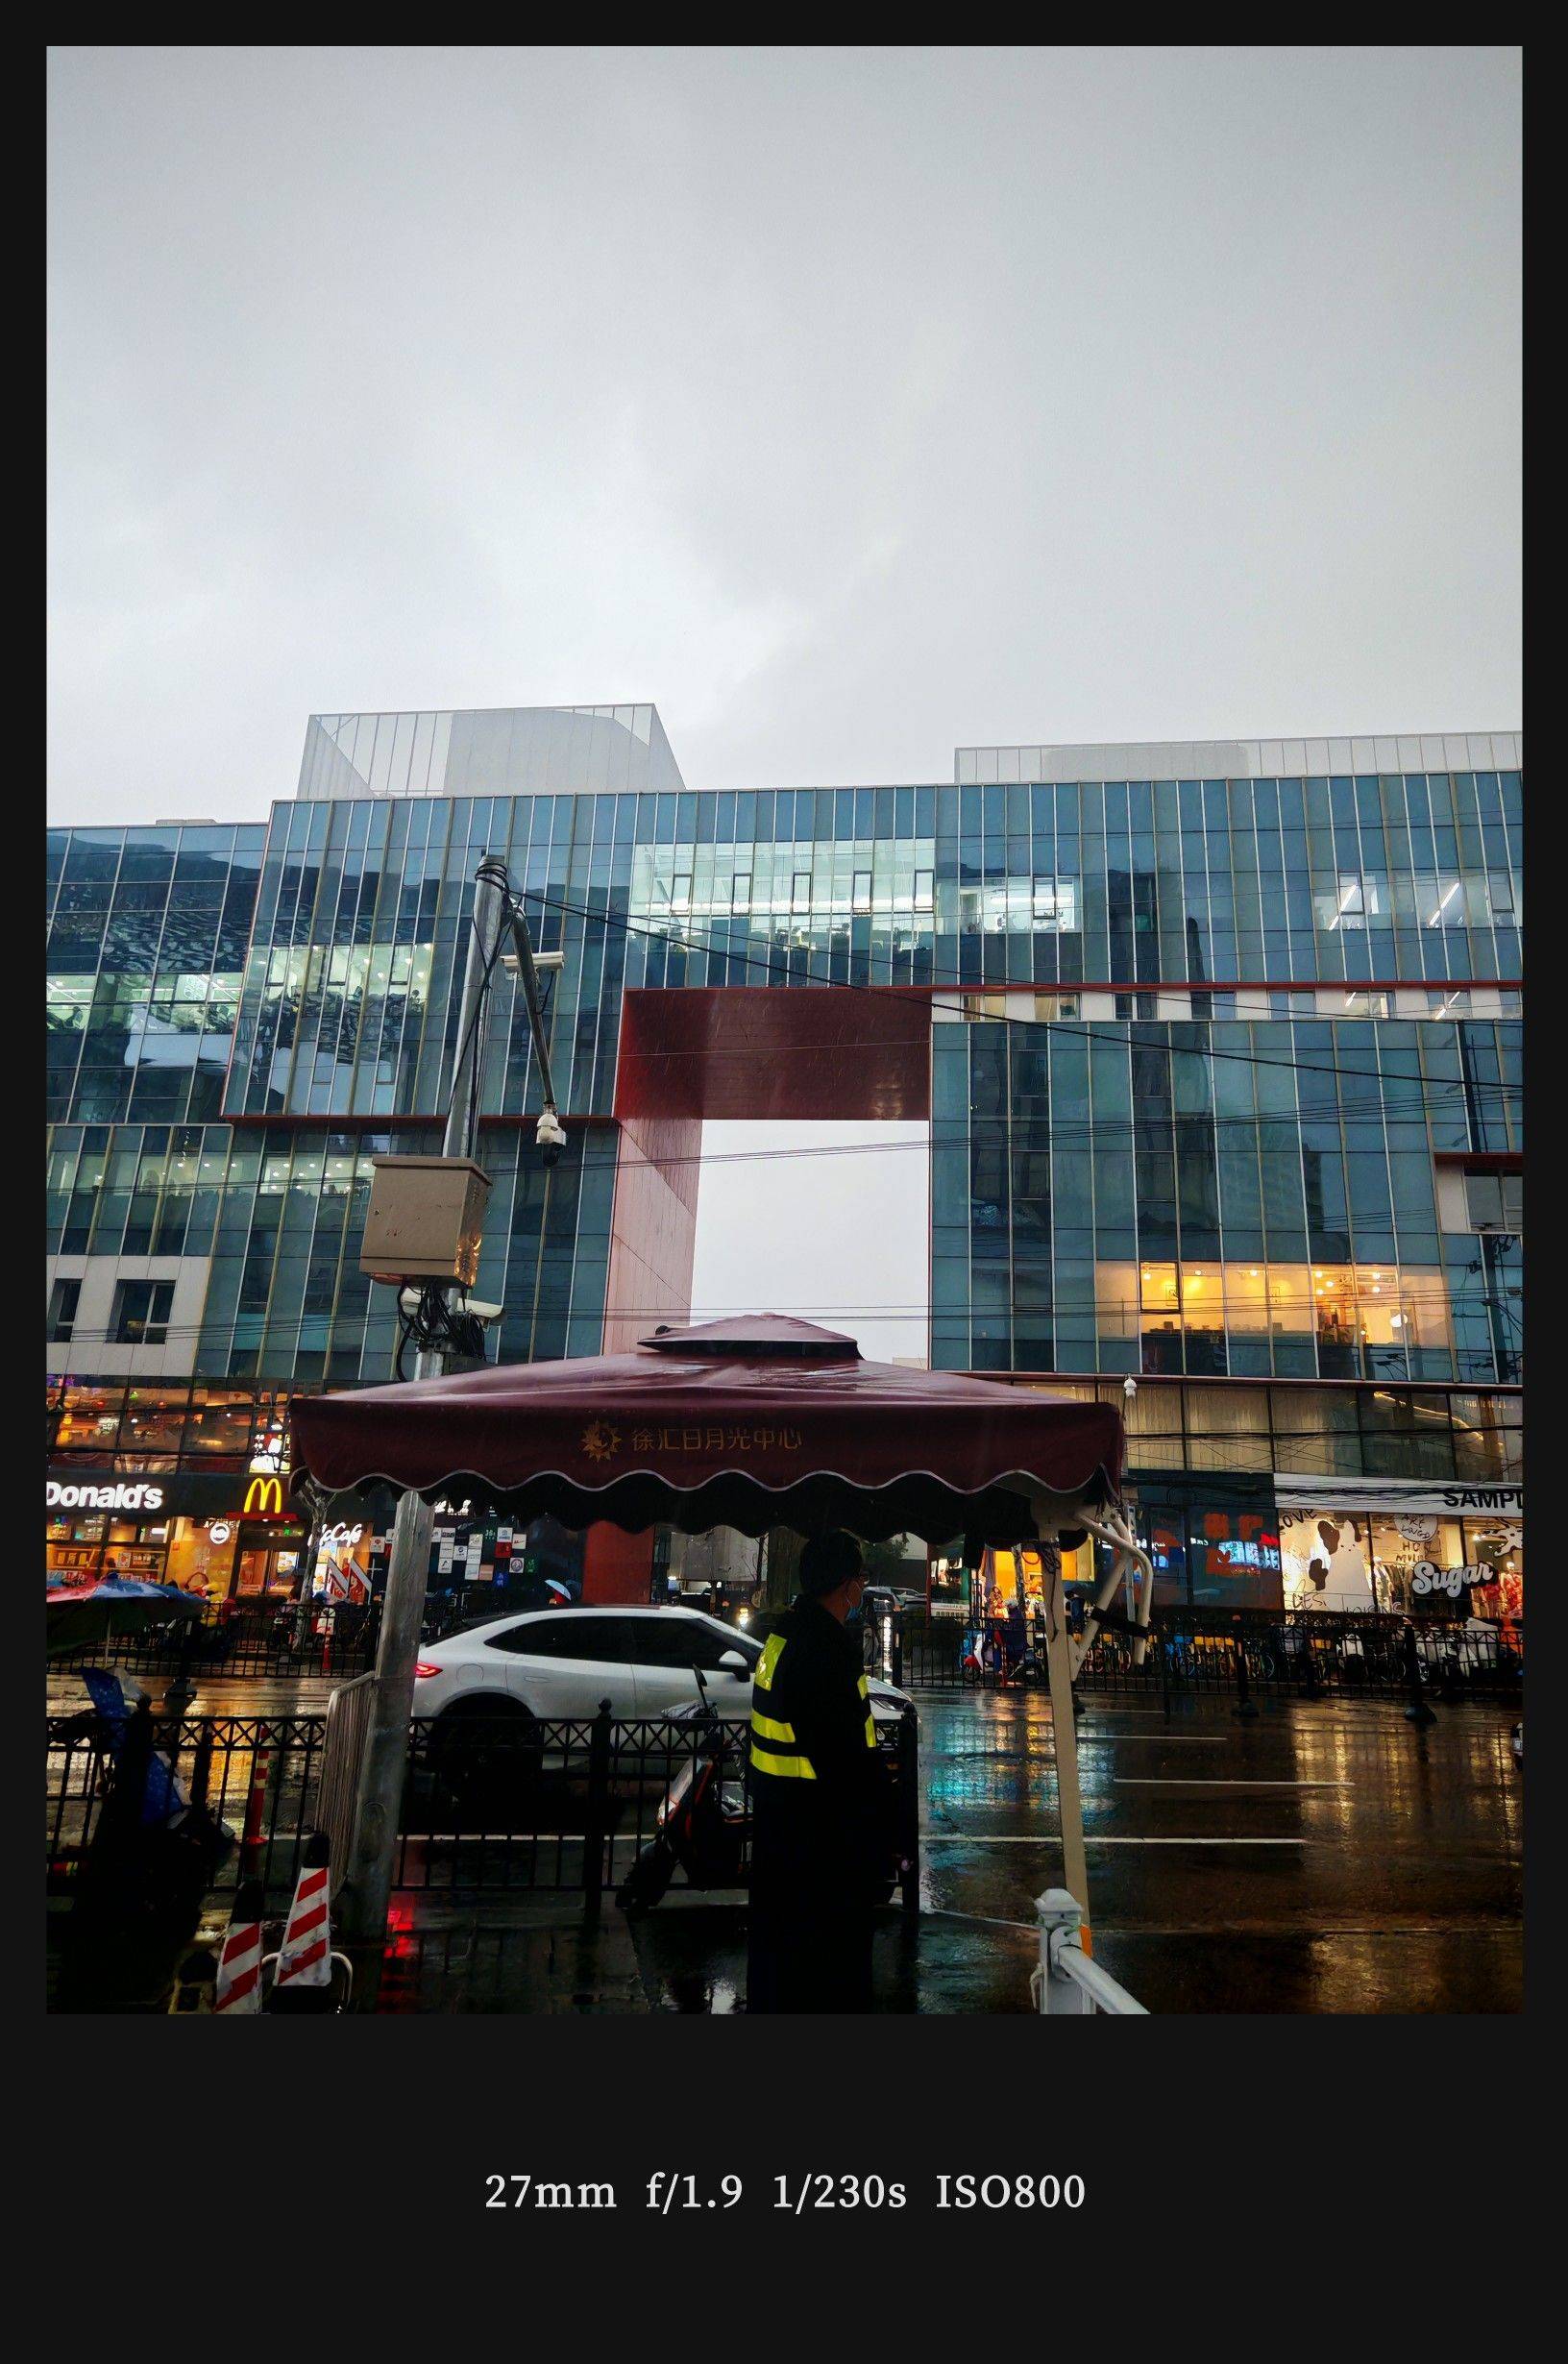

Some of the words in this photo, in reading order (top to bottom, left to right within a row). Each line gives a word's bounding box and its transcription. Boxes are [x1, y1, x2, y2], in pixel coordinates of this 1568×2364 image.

[631, 1427, 803, 1452] 徐汇日月光中心
[45, 1481, 163, 1510] Donald's
[1412, 1561, 1496, 1598] Sugar
